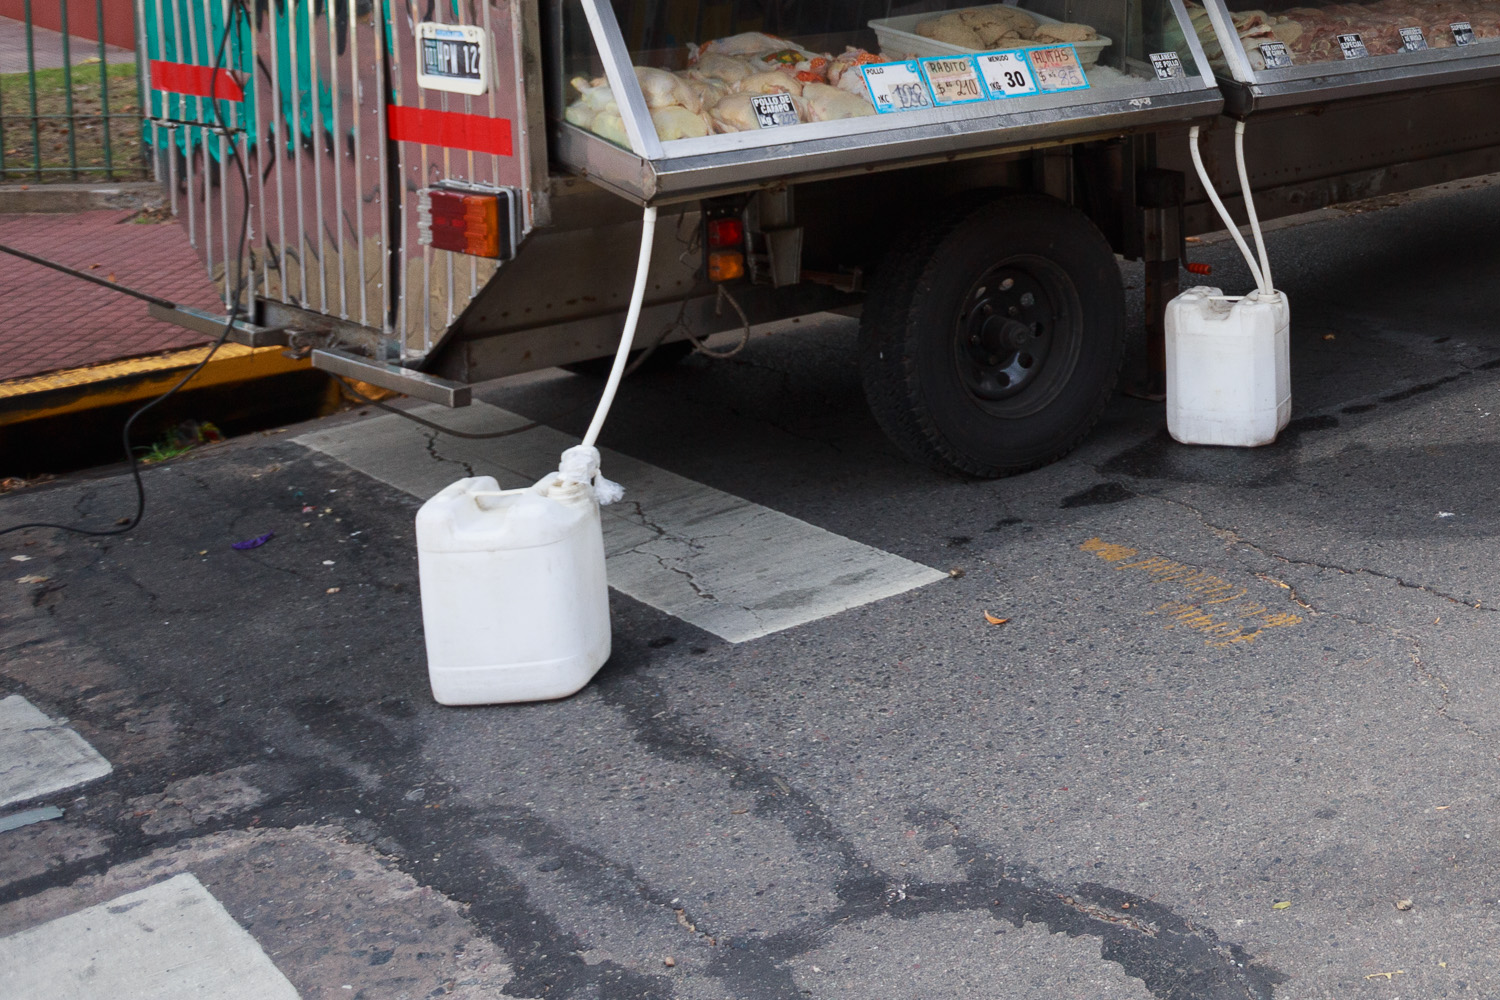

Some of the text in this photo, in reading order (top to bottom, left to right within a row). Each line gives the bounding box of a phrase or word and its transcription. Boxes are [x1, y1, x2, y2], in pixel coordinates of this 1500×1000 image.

[1033, 48, 1069, 64] ALITAS
[929, 61, 967, 73] RABITO
[1004, 71, 1026, 88] 30
[956, 79, 979, 96] 210
[754, 95, 791, 107] POLLO DE
[760, 103, 789, 114] CAMPO
[760, 114, 773, 126] Kg
